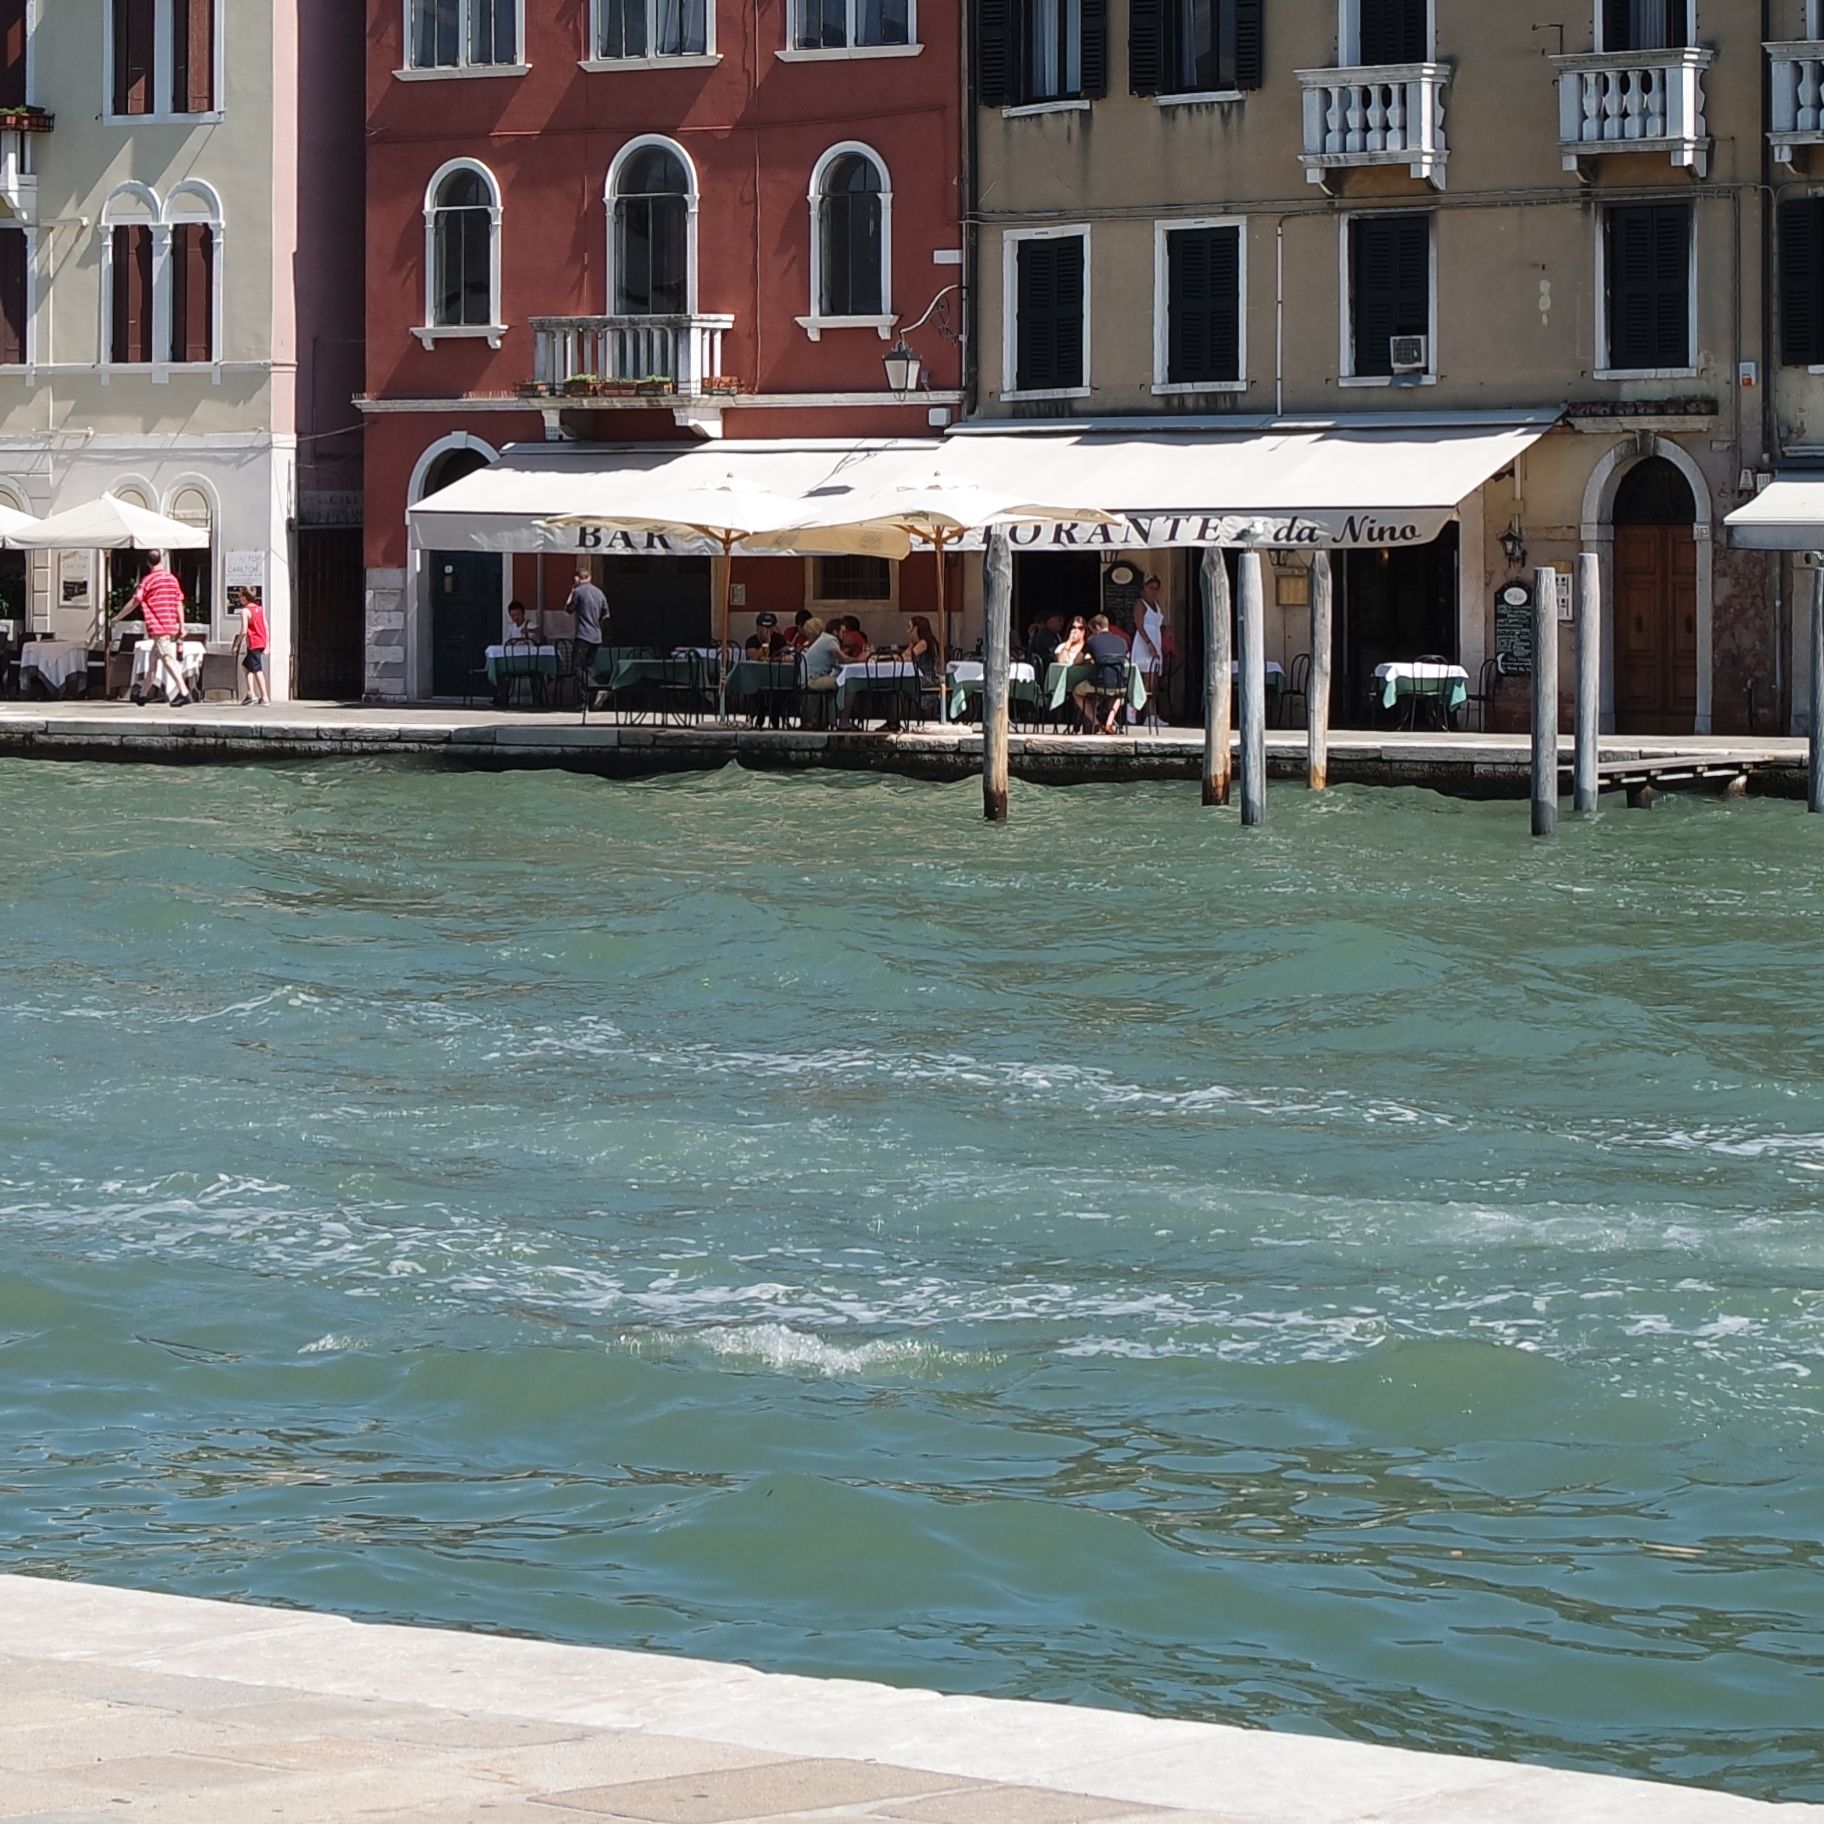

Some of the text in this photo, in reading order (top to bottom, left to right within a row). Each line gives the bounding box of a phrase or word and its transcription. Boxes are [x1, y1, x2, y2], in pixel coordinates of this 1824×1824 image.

[574, 525, 673, 550] BAR
[918, 514, 1224, 547] ORANTE
[1272, 515, 1320, 543] da
[1331, 514, 1422, 543] Nino
